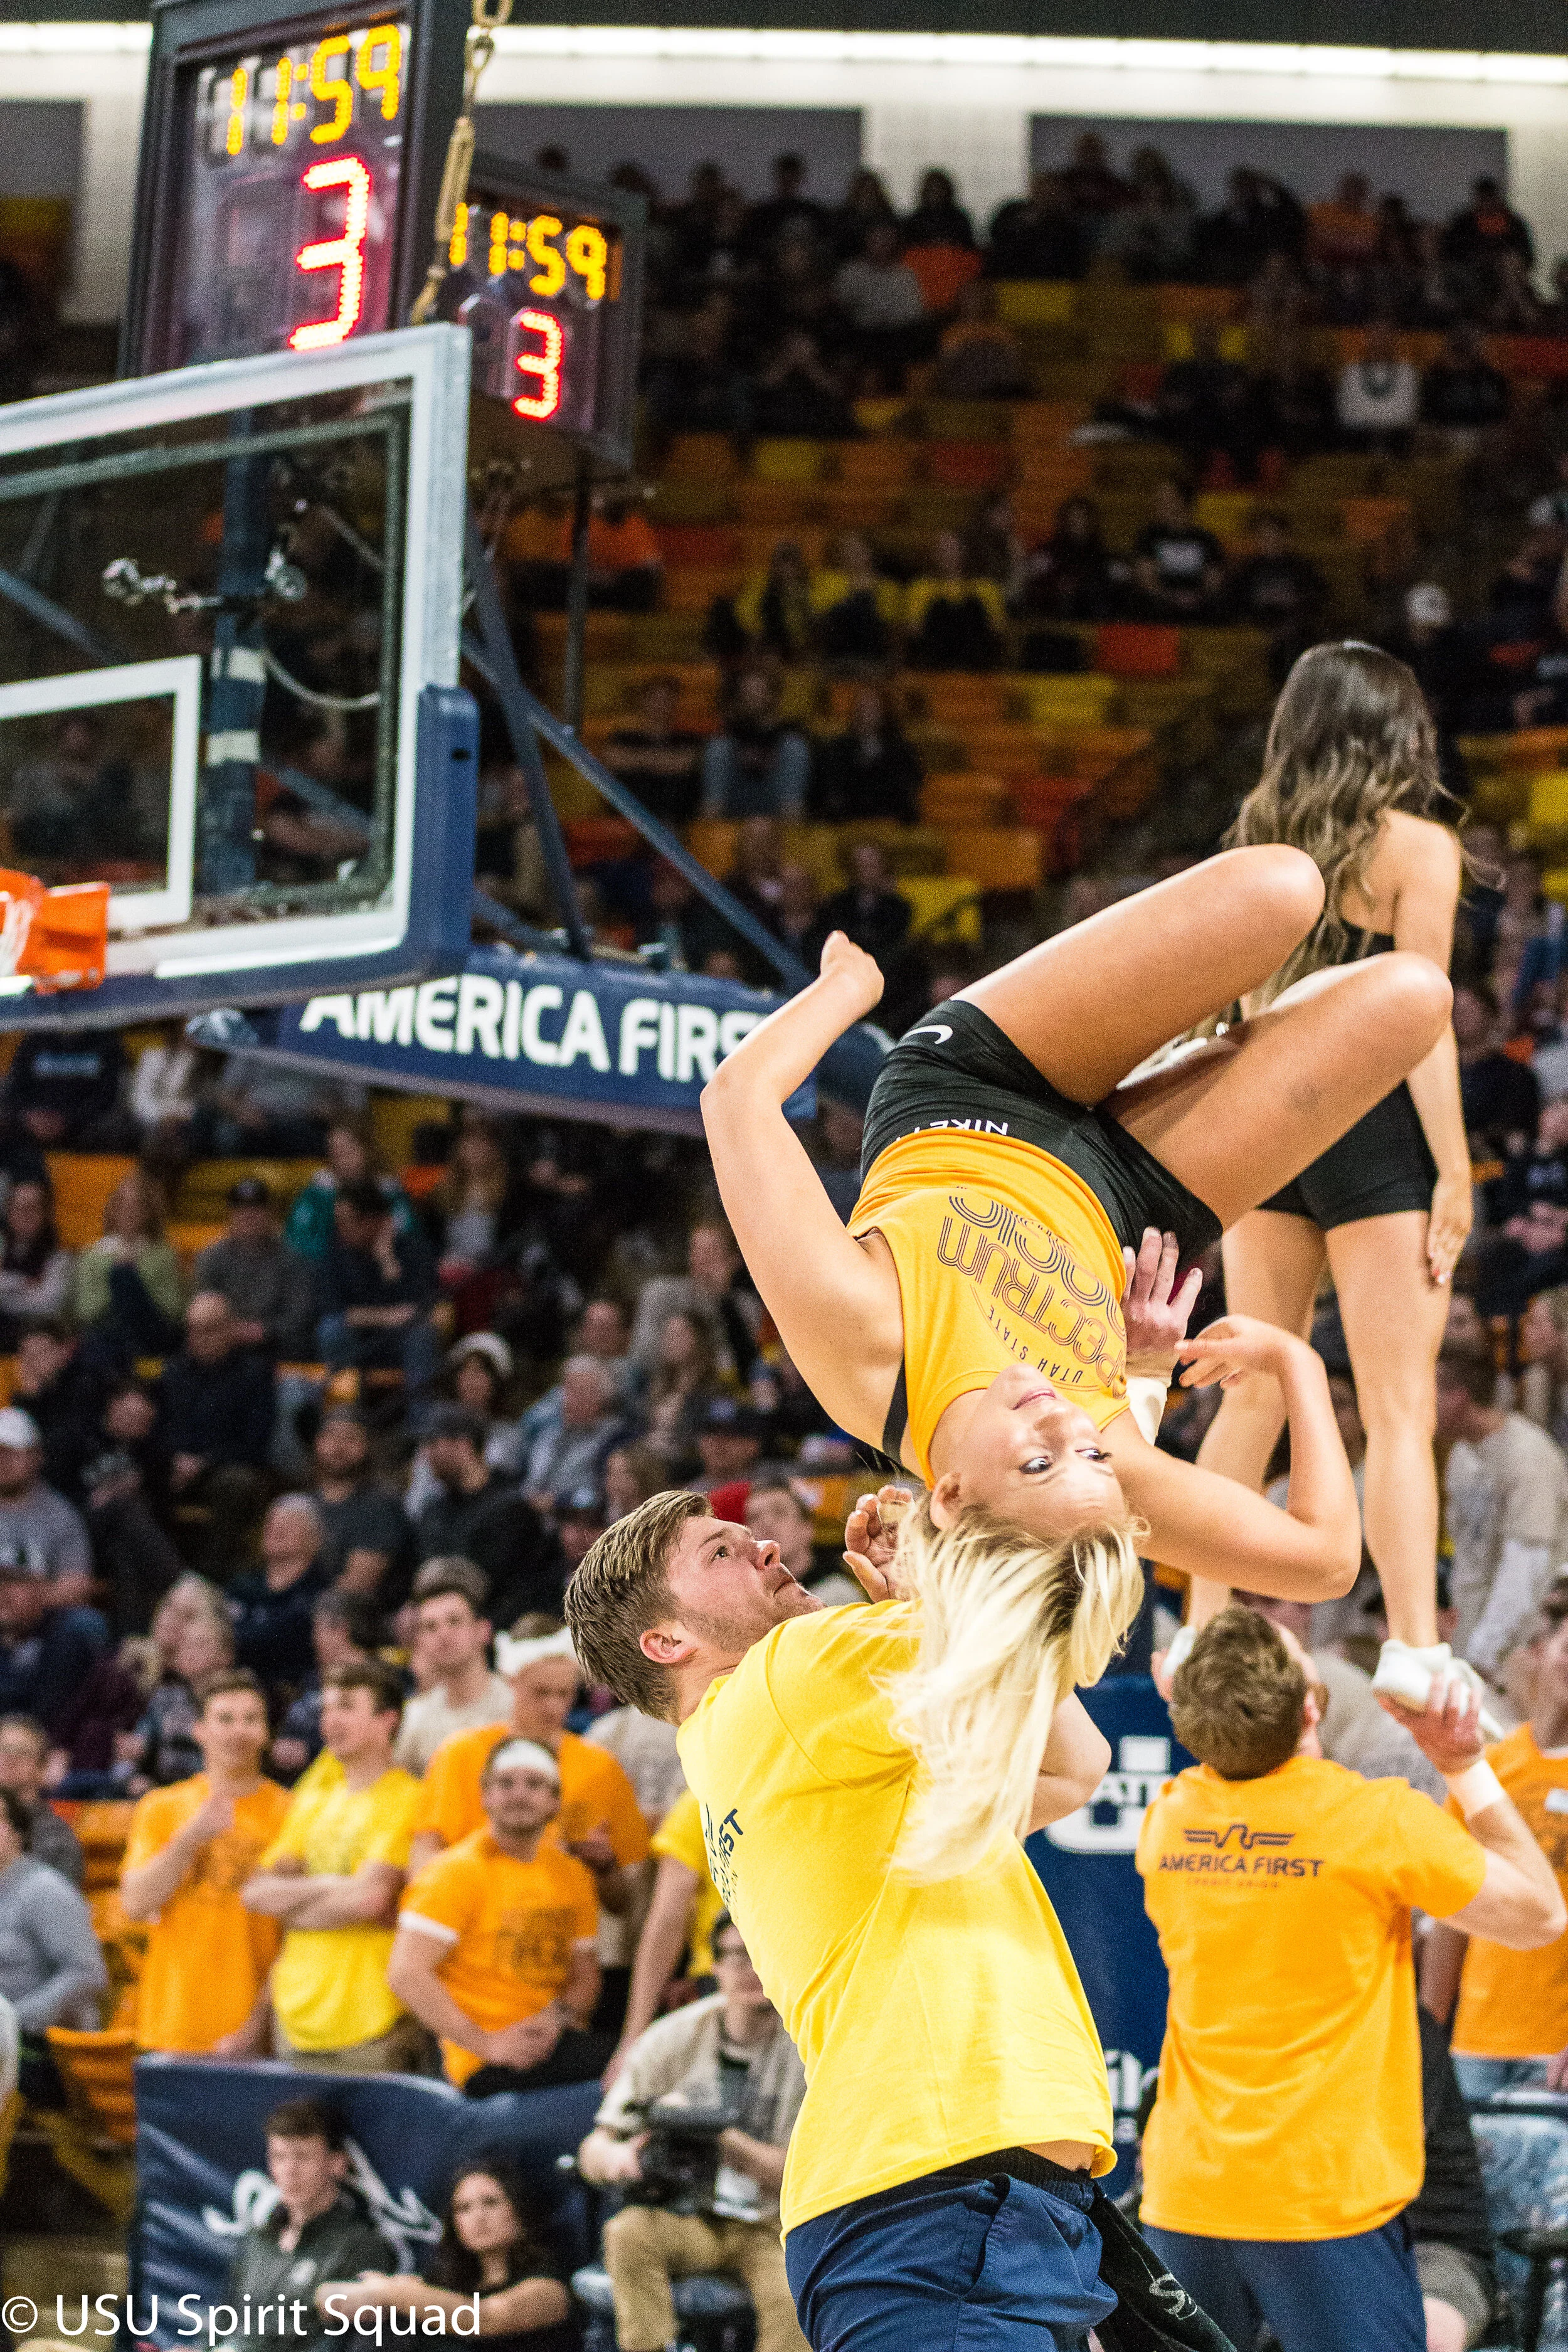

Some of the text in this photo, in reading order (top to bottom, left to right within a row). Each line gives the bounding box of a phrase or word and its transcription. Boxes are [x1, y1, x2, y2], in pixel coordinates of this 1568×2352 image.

[226, 23, 402, 155] 11:59
[289, 156, 371, 352] 3
[449, 202, 608, 300] 11:59
[513, 309, 563, 422] 3
[300, 974, 612, 1072] AMERICA
[988, 1305, 1083, 1384] UTAH STATE
[1158, 1854, 1324, 1877] AMERICA FIRST
